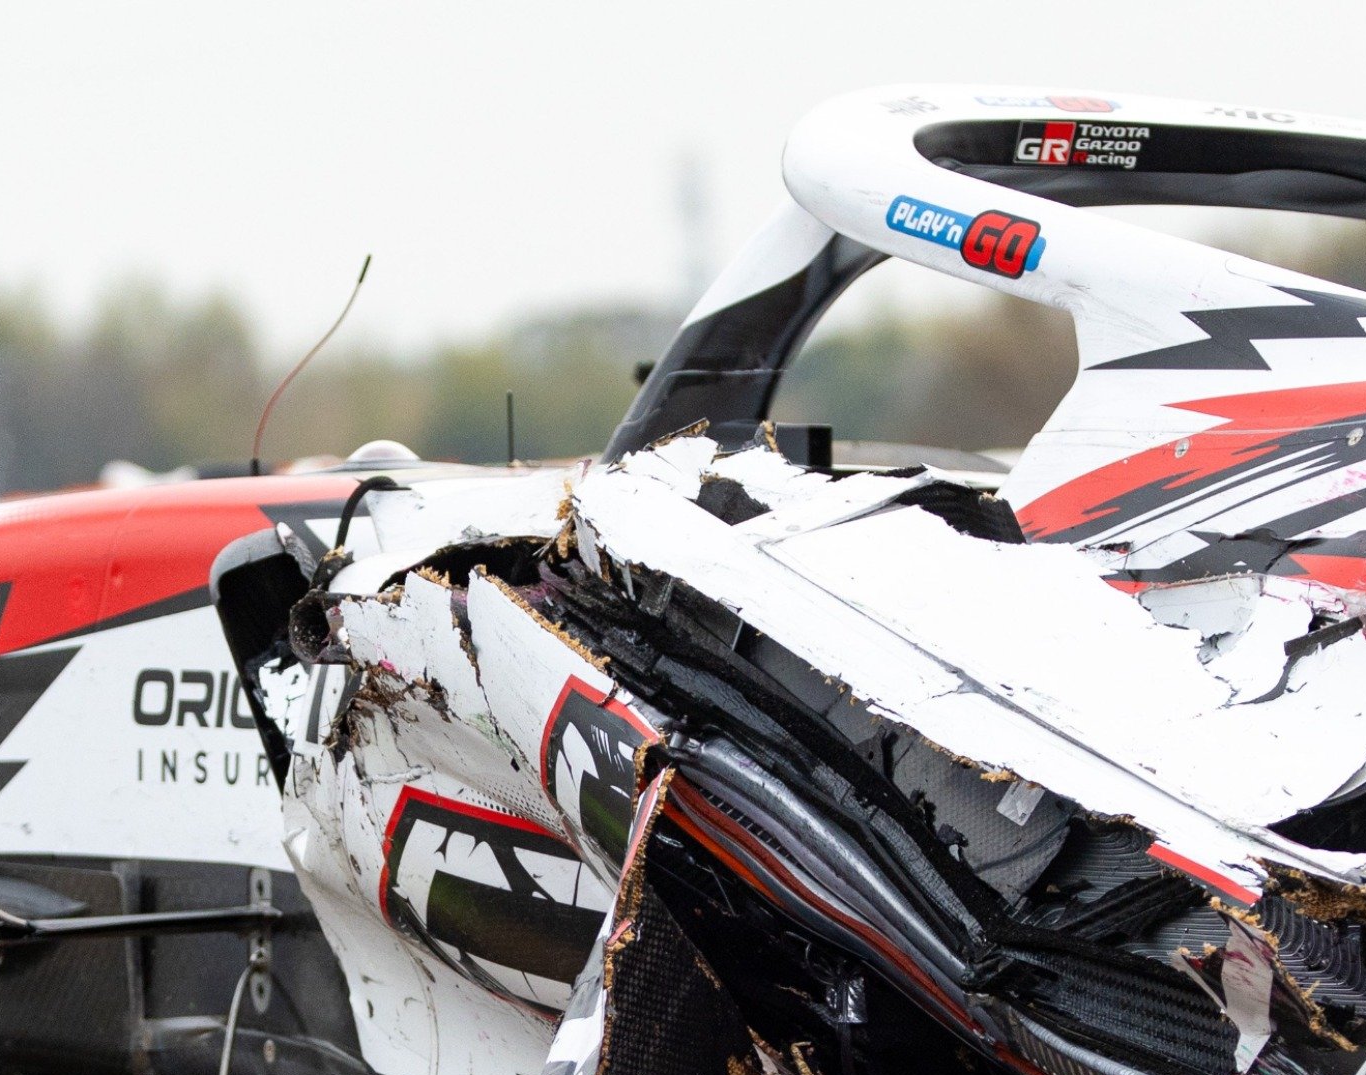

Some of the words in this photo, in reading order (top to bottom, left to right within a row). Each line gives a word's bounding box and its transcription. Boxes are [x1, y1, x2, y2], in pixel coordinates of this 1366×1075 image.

[1080, 124, 1150, 138] TOYOTA
[1017, 138, 1070, 161] GR
[1075, 139, 1141, 151] GAZOO
[1073, 151, 1137, 169] Racing
[966, 212, 1040, 279] GO
